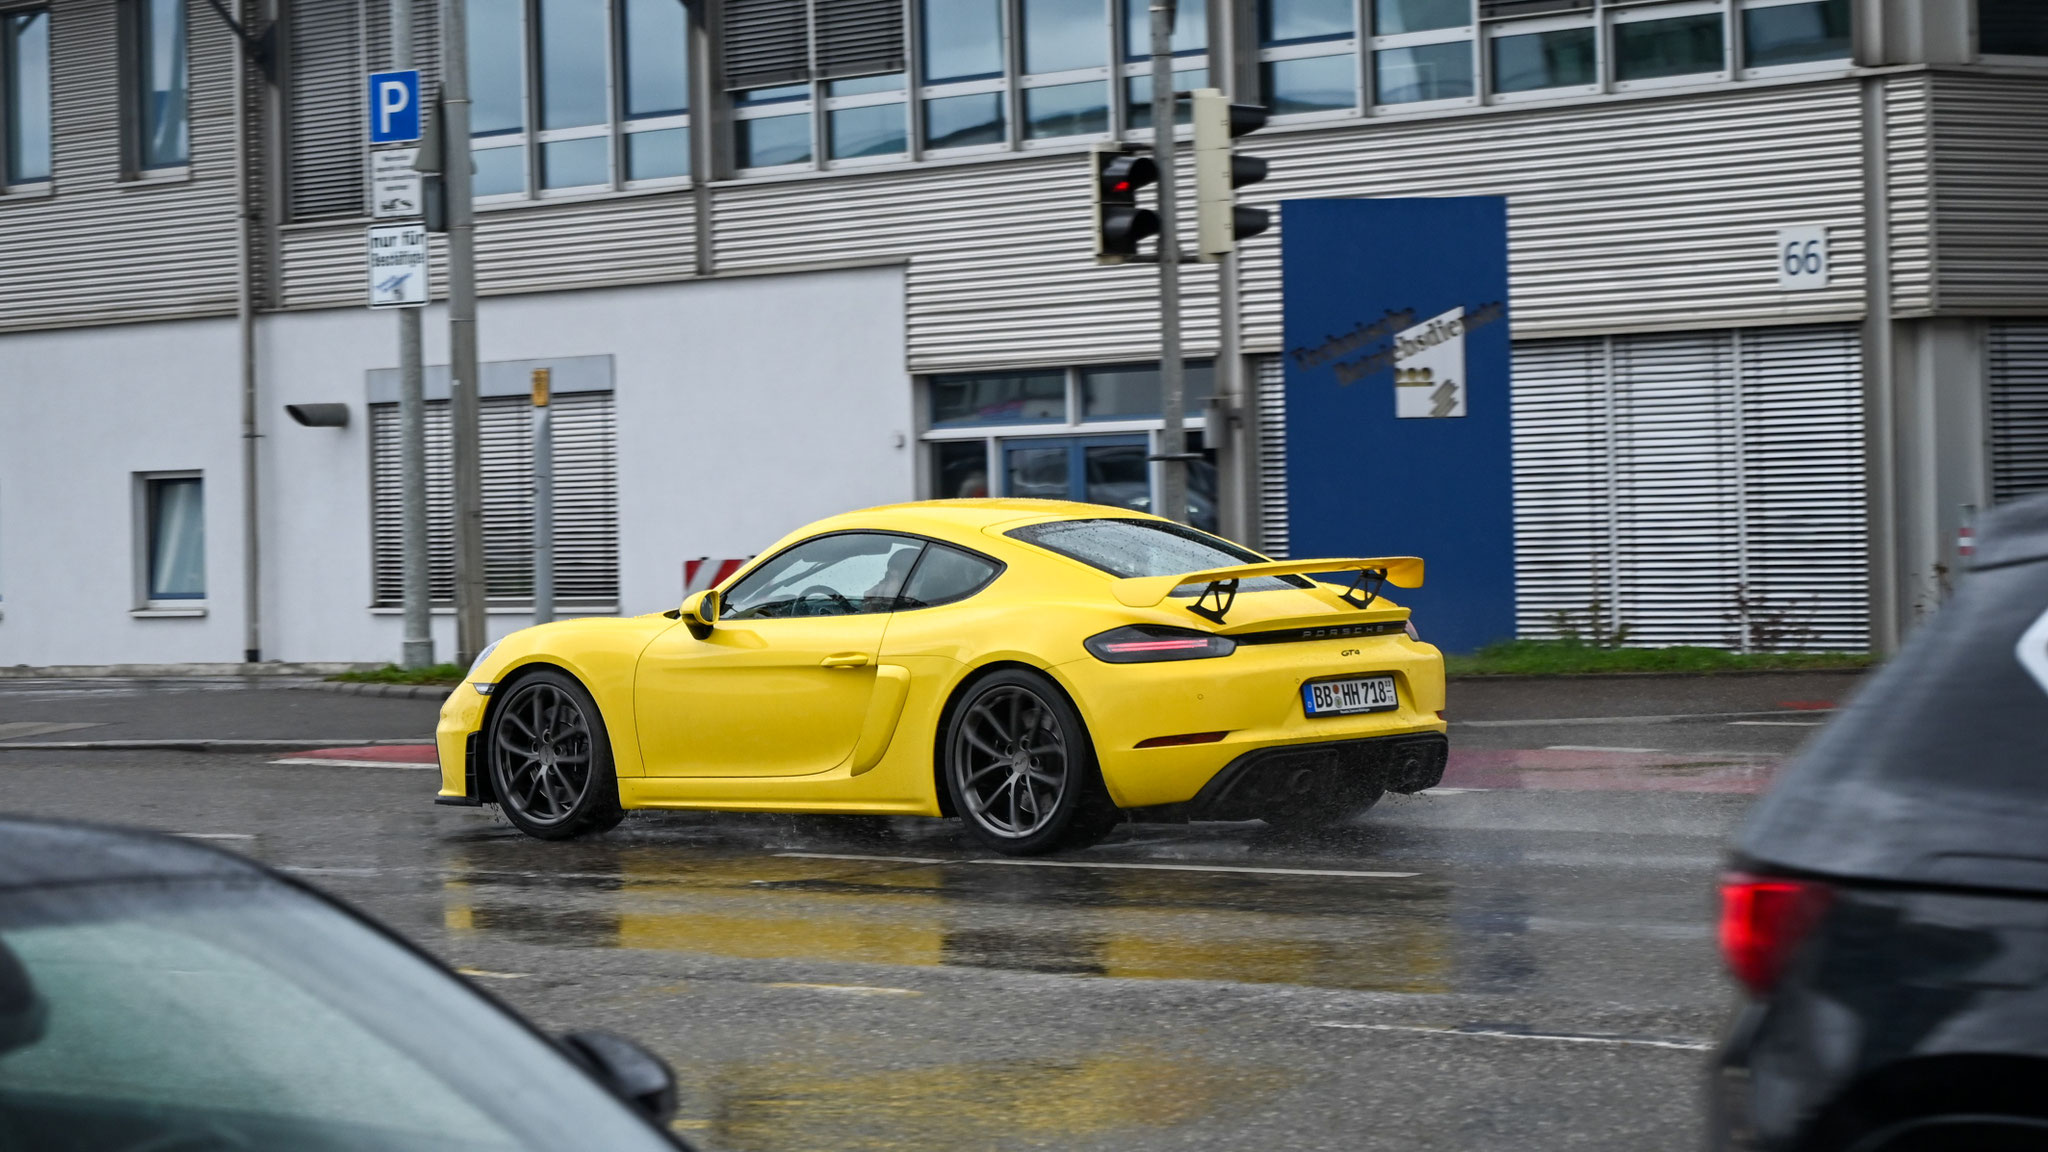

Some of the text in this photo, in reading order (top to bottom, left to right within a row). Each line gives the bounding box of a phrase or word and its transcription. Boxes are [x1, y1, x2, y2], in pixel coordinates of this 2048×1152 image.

[380, 81, 410, 133] P
[371, 230, 425, 248] nur für
[1784, 240, 1822, 276] 66
[1302, 625, 1384, 638] PORSCHE
[1313, 681, 1387, 709] BB HH 718
